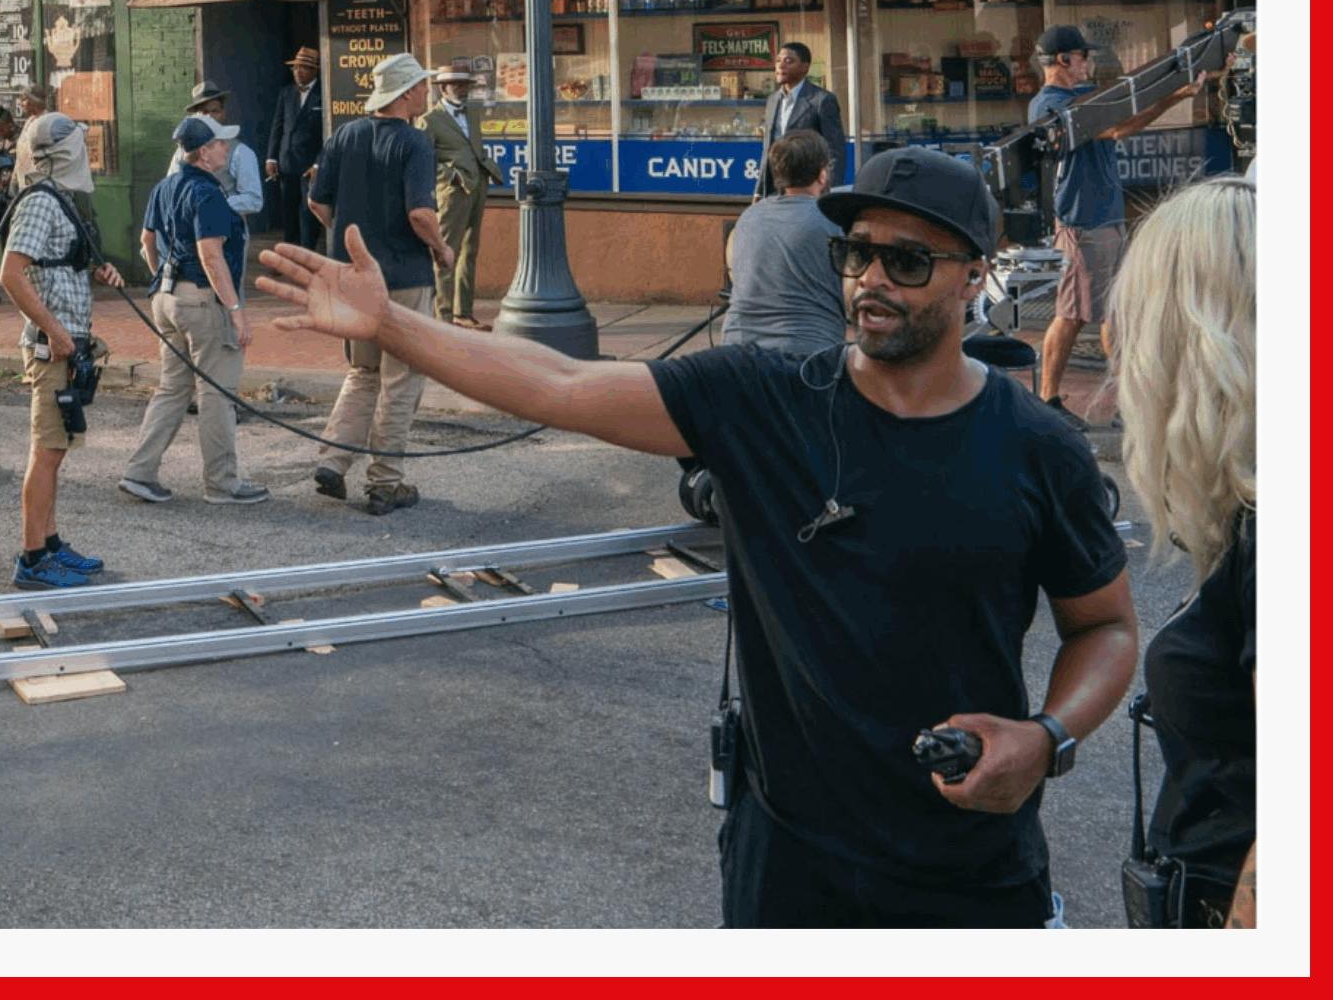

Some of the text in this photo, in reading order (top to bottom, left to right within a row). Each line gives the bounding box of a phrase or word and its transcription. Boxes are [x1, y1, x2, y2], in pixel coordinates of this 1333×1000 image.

[349, 38, 384, 51] GOLD
[702, 38, 770, 54] FELS-NAPTHA
[339, 55, 395, 68] CROWN
[332, 100, 368, 115] BRIDG
[514, 145, 577, 164] HE
[647, 157, 761, 179] CANDY &
